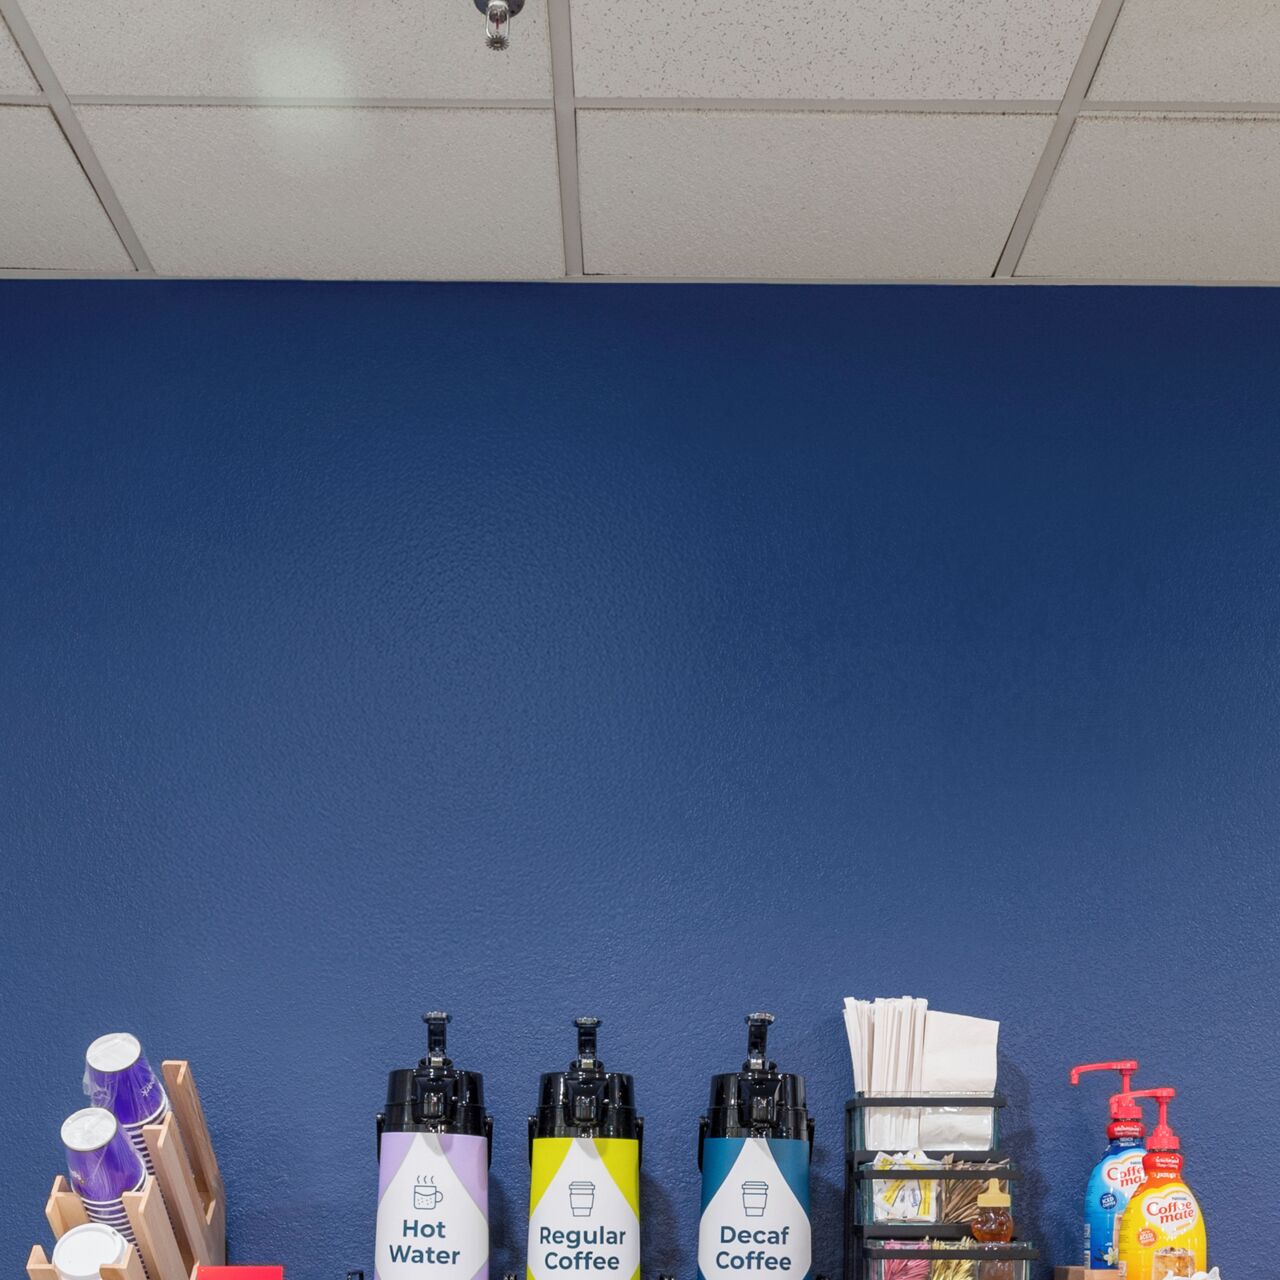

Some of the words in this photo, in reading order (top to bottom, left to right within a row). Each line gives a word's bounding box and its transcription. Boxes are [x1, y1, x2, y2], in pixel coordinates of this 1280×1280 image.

[1146, 1201, 1192, 1216] Coffee
[1160, 1209, 1194, 1224] mate
[403, 1220, 446, 1238] Hot
[540, 1226, 626, 1247] Regular
[720, 1226, 789, 1244] Decaf
[389, 1244, 460, 1264] Water
[545, 1251, 620, 1270] Coffee
[716, 1251, 792, 1270] Coffee
